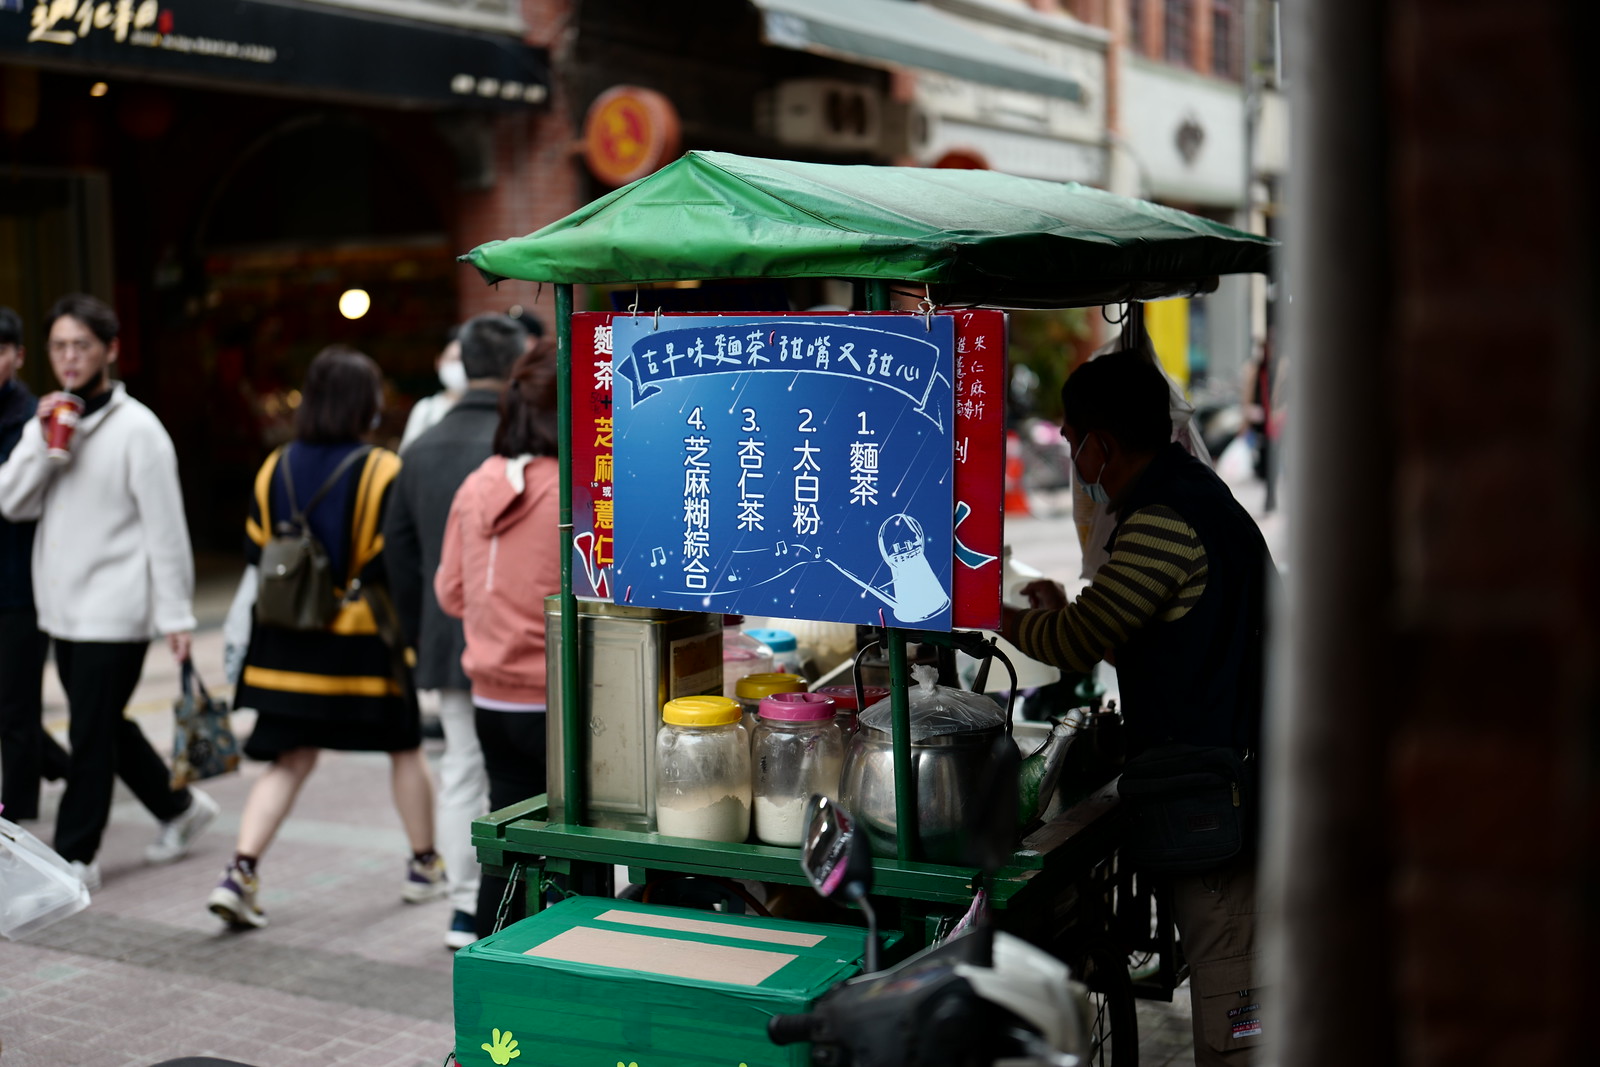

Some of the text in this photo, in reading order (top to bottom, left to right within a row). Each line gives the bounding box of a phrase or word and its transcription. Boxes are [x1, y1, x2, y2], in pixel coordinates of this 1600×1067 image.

[683, 406, 710, 589] 4. 芝麻糊綜合
[737, 408, 765, 532] 3. 杏仁茶
[792, 408, 821, 535] 2. 太白粉
[850, 411, 879, 506] 1. 麵茶
